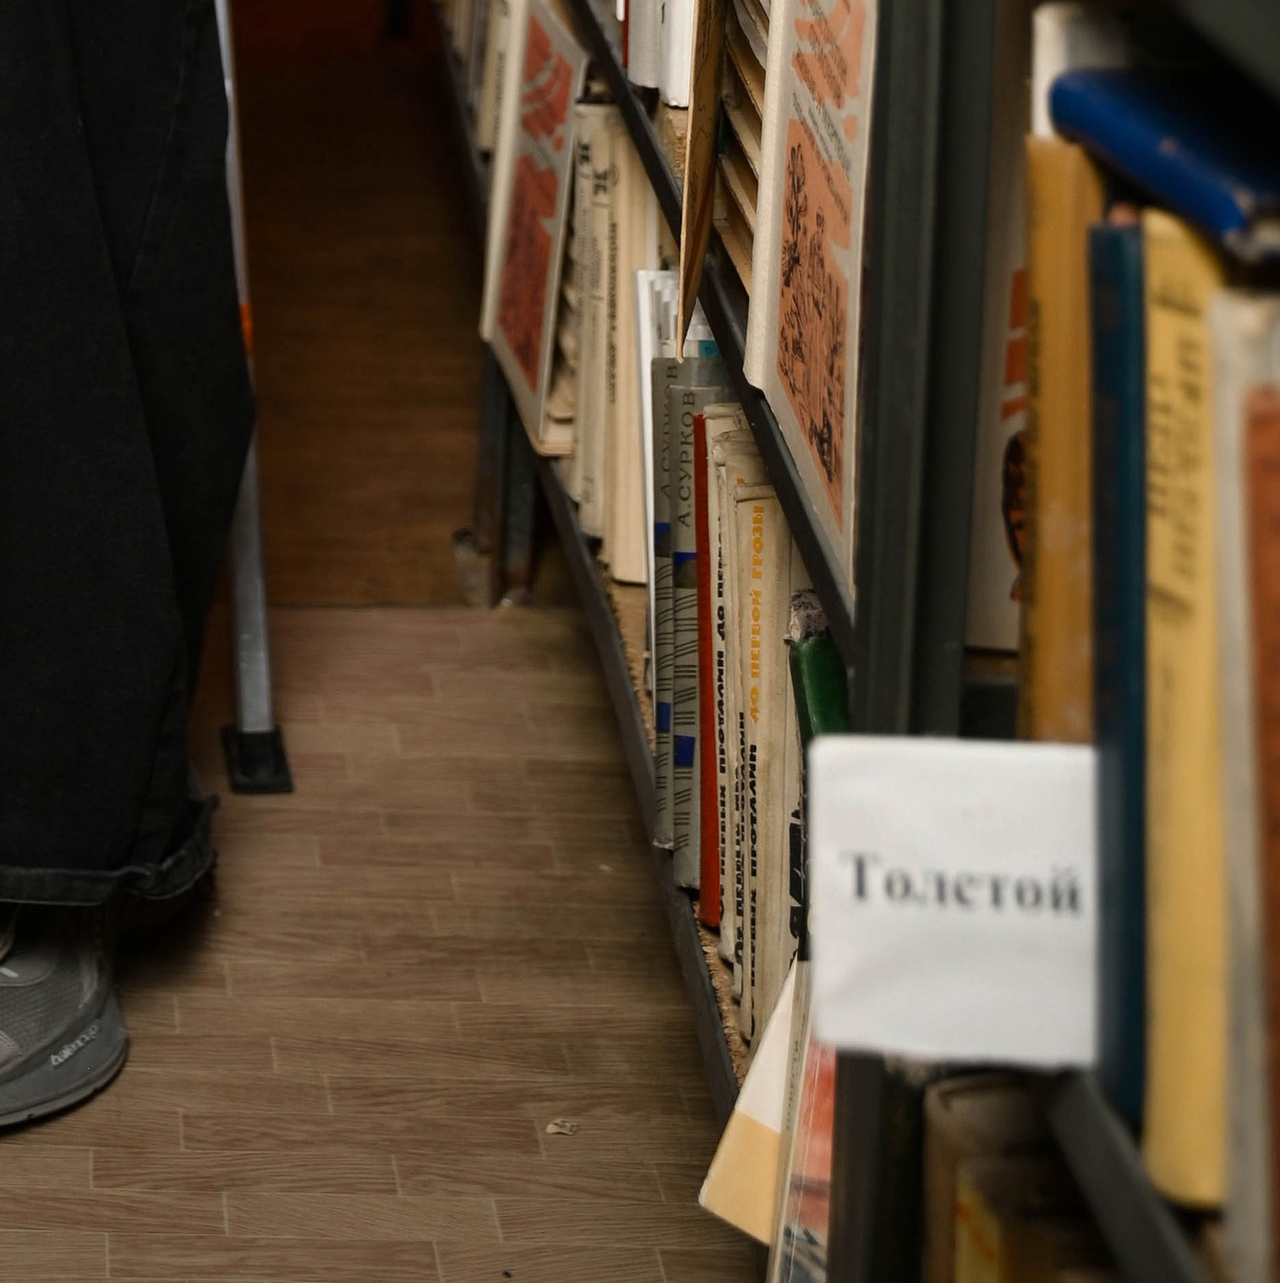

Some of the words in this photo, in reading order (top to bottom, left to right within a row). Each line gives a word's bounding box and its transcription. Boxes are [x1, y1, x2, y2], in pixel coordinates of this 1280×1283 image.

[677, 391, 695, 528] А.СУРКОВ
[751, 505, 764, 580] ГРОЗЫ
[716, 604, 726, 642] ДО
[749, 588, 762, 679] ПЕРВОЙ
[715, 650, 726, 775] ПРОТАЛИН
[748, 686, 761, 725] ДО
[748, 744, 757, 877] ПРОТАЛИН
[840, 849, 1083, 919] Толстой
